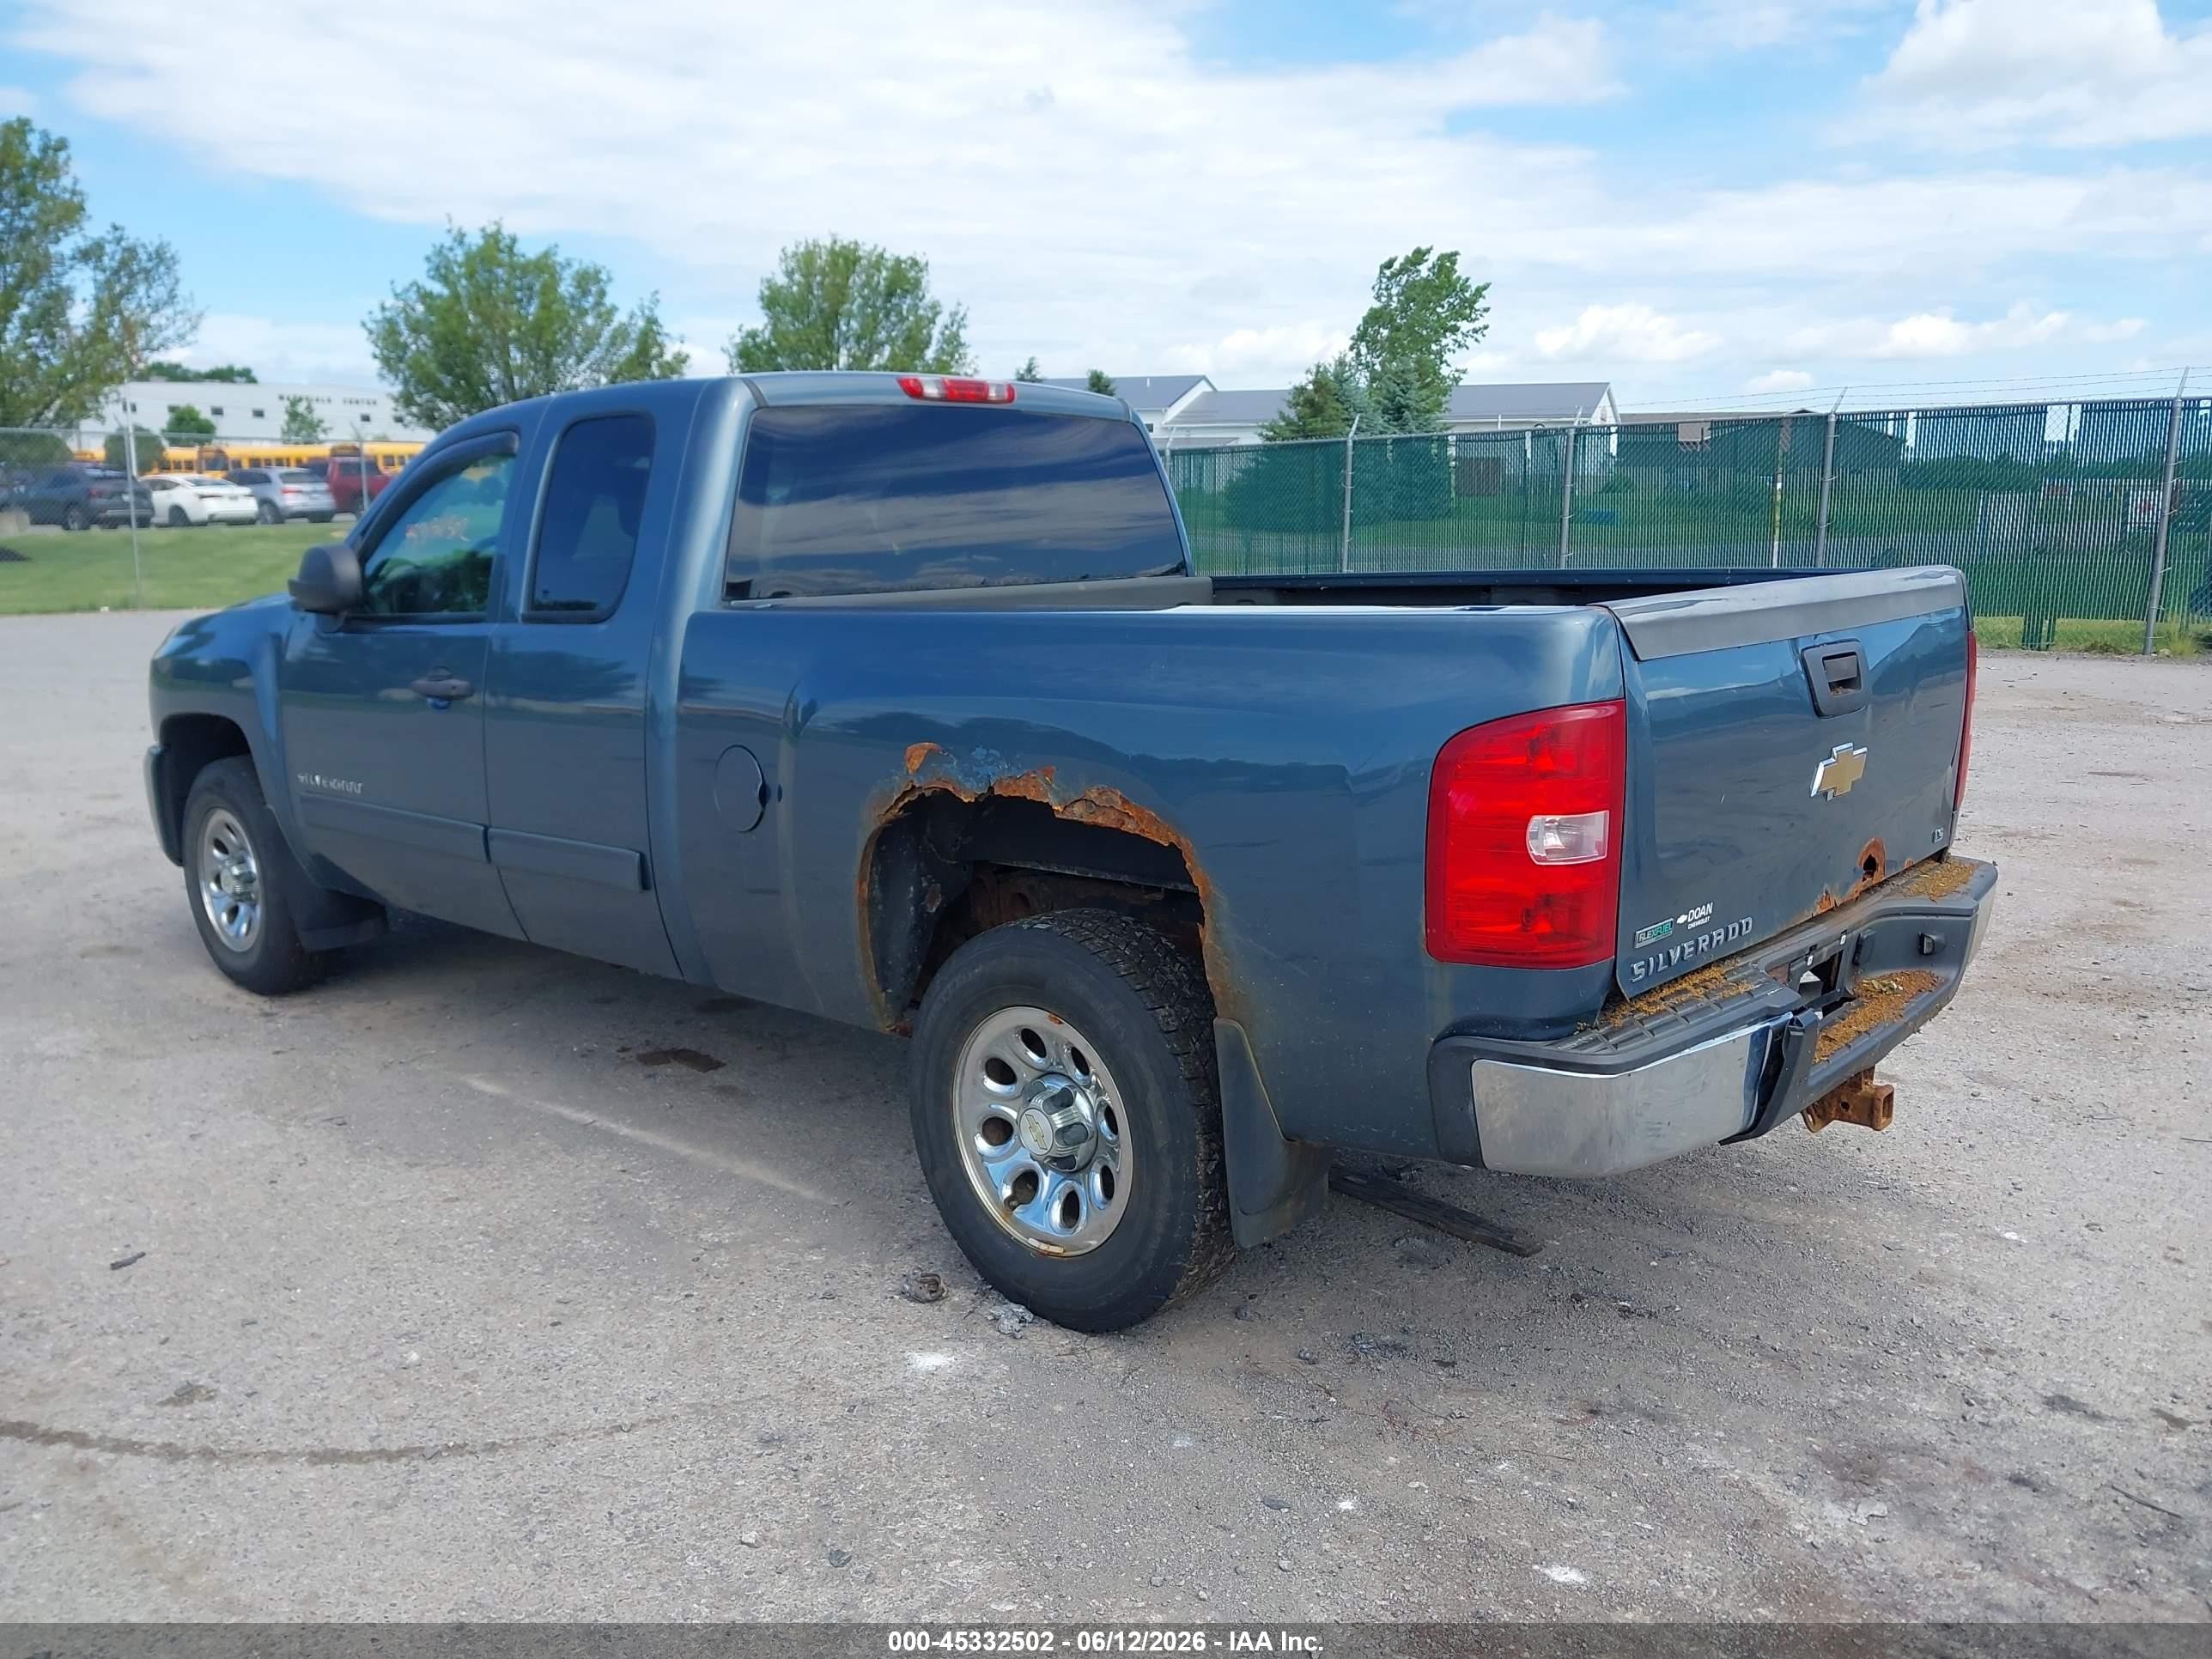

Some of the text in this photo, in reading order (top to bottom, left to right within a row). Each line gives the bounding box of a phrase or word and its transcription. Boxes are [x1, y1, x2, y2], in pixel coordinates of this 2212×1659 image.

[1688, 902, 1713, 922] DOAN
[1687, 915, 1711, 930] CHEVROLET
[1631, 916, 1753, 983] SILVERADO
